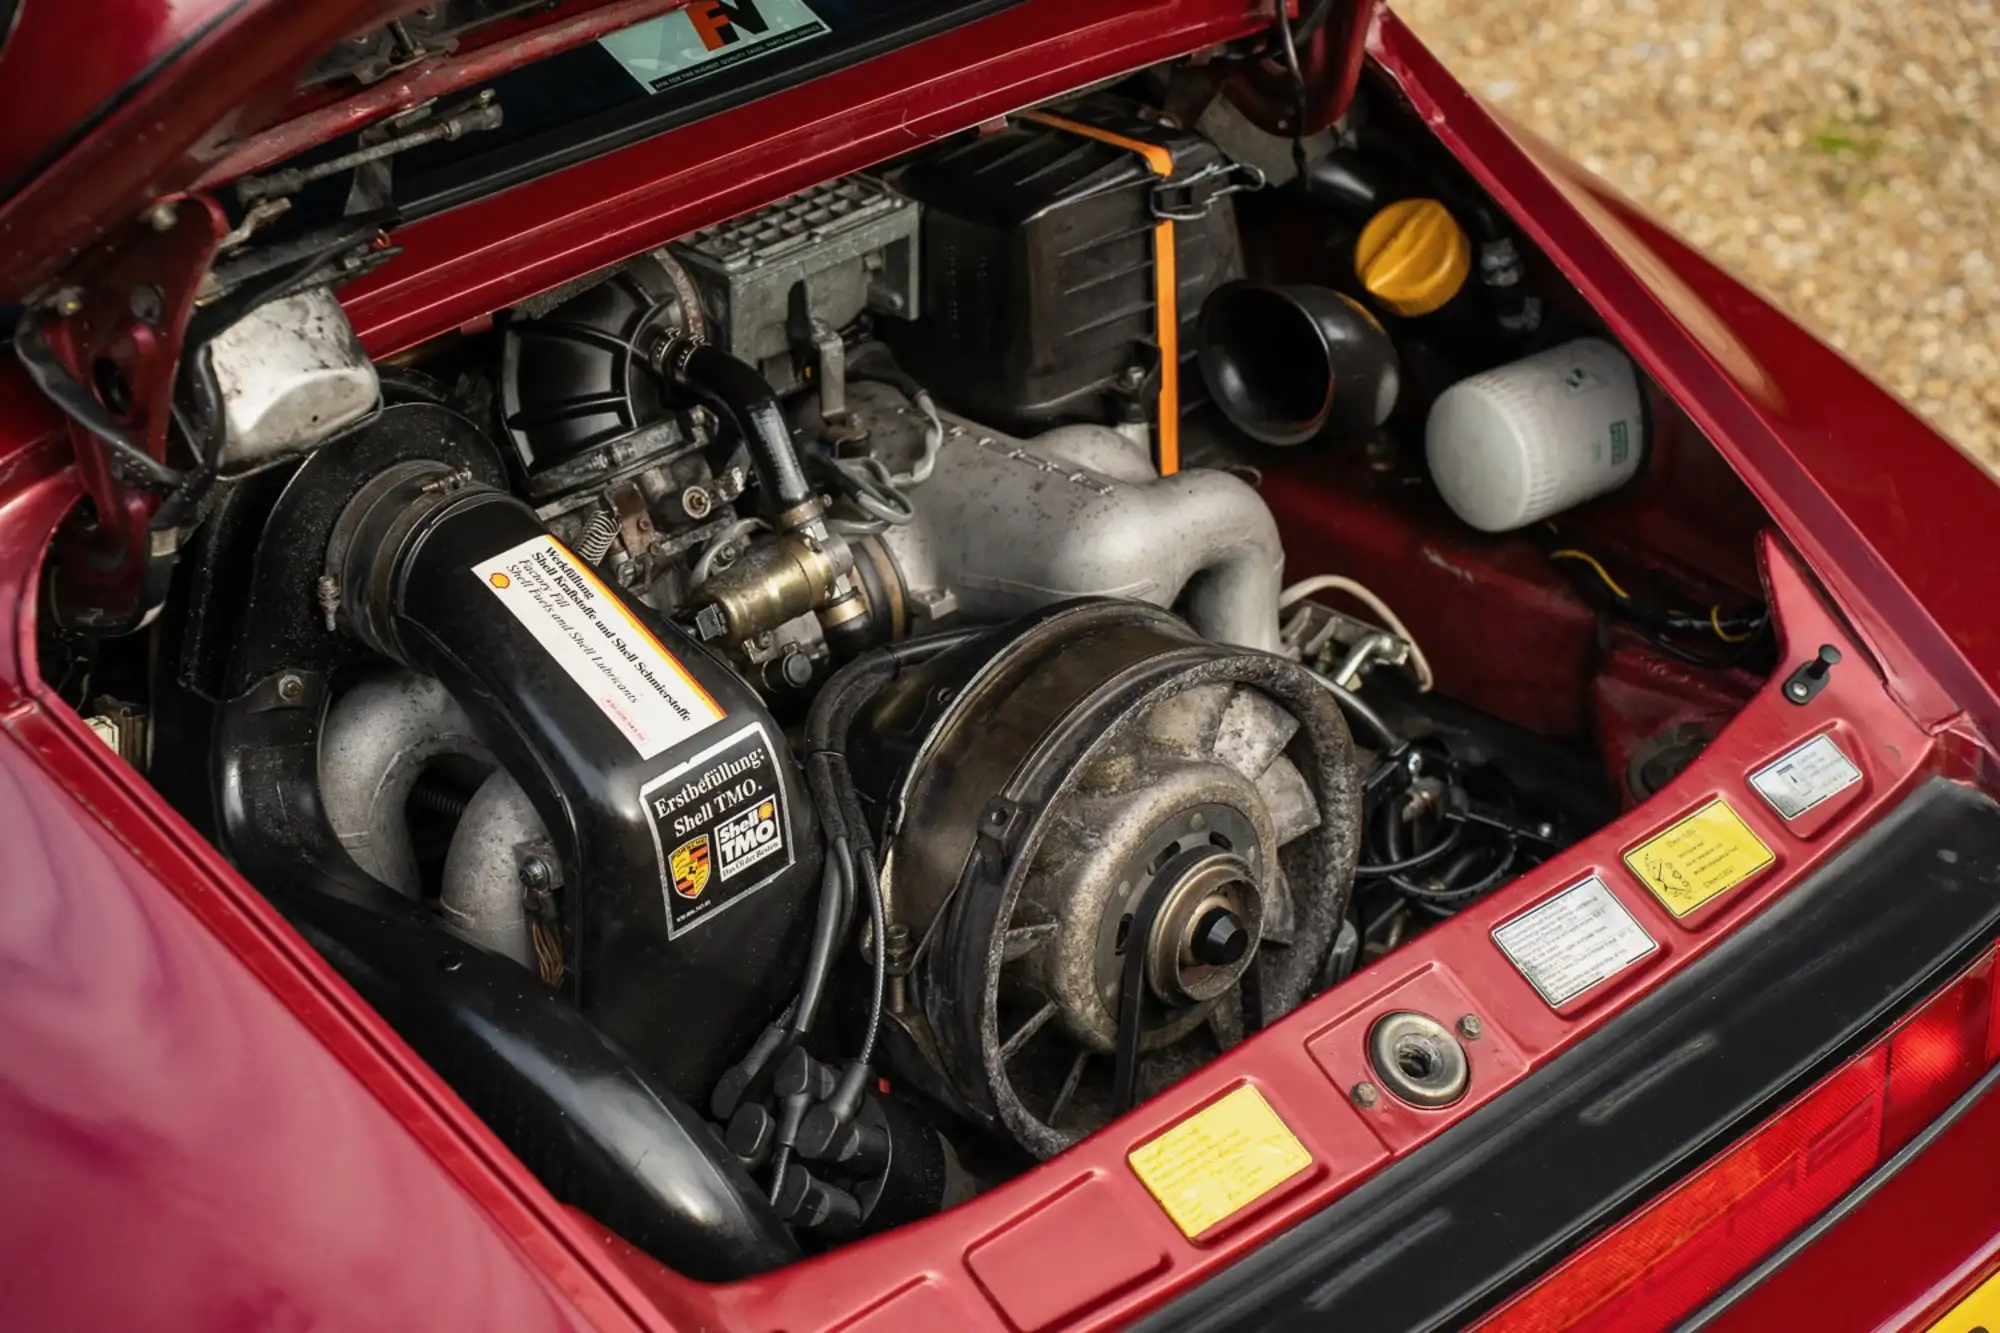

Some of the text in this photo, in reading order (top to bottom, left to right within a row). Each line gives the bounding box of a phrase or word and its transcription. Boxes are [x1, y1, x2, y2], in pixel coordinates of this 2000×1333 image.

[668, 75, 681, 83] FOR
[681, 70, 694, 79] THE
[694, 61, 720, 75] HIGHEST
[518, 558, 570, 608] Factory Fill
[545, 546, 595, 600] Werkfüllung
[506, 563, 532, 588] Shell
[528, 585, 554, 614] Fuels
[551, 613, 572, 634] and
[568, 631, 595, 655] Shell
[591, 655, 638, 704] Lubricants
[532, 551, 692, 723] Shell Kraftstoffe und Shell Schmierstoffe
[653, 748, 765, 819] Erstbefüllung:
[673, 777, 763, 838] Shell TMO.
[720, 808, 759, 844] Shell
[720, 819, 776, 864] TMO
